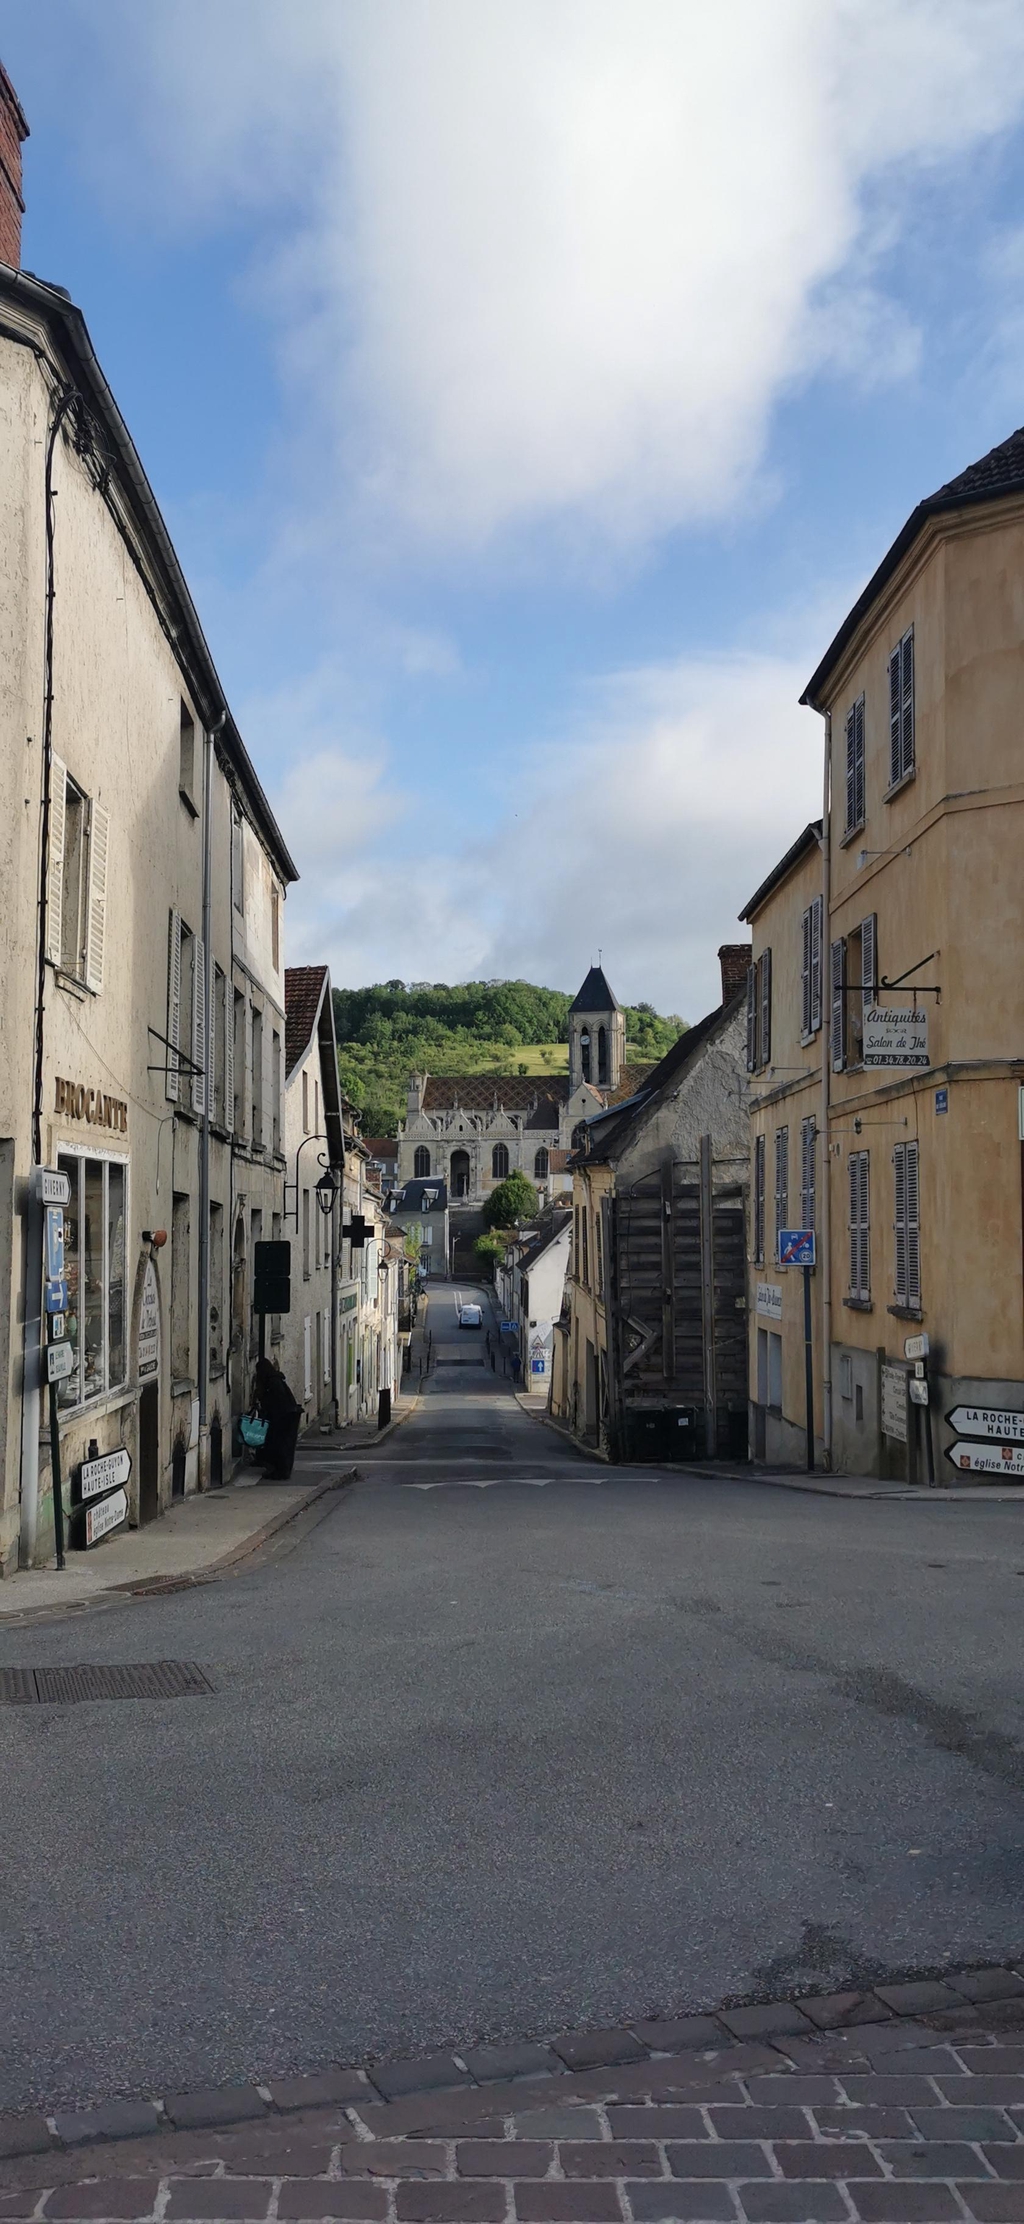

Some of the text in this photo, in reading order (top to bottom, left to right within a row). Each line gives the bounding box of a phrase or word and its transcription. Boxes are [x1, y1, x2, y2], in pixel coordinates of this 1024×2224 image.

[867, 1010, 926, 1027] Antiquités
[866, 1036, 926, 1050] Salon de Thé
[873, 1055, 928, 1065] 01.34.78.20.24
[54, 1076, 128, 1132] BROCANTE
[44, 1178, 66, 1197] GIVERNY
[966, 1410, 979, 1422] LA
[987, 1424, 1024, 1437] HAUTE
[83, 1454, 124, 1480] LA ROCHE-GUYON
[974, 1457, 1001, 1470] église
[83, 1471, 115, 1494] HAUTE-ISLE
[93, 1503, 110, 1522] château
